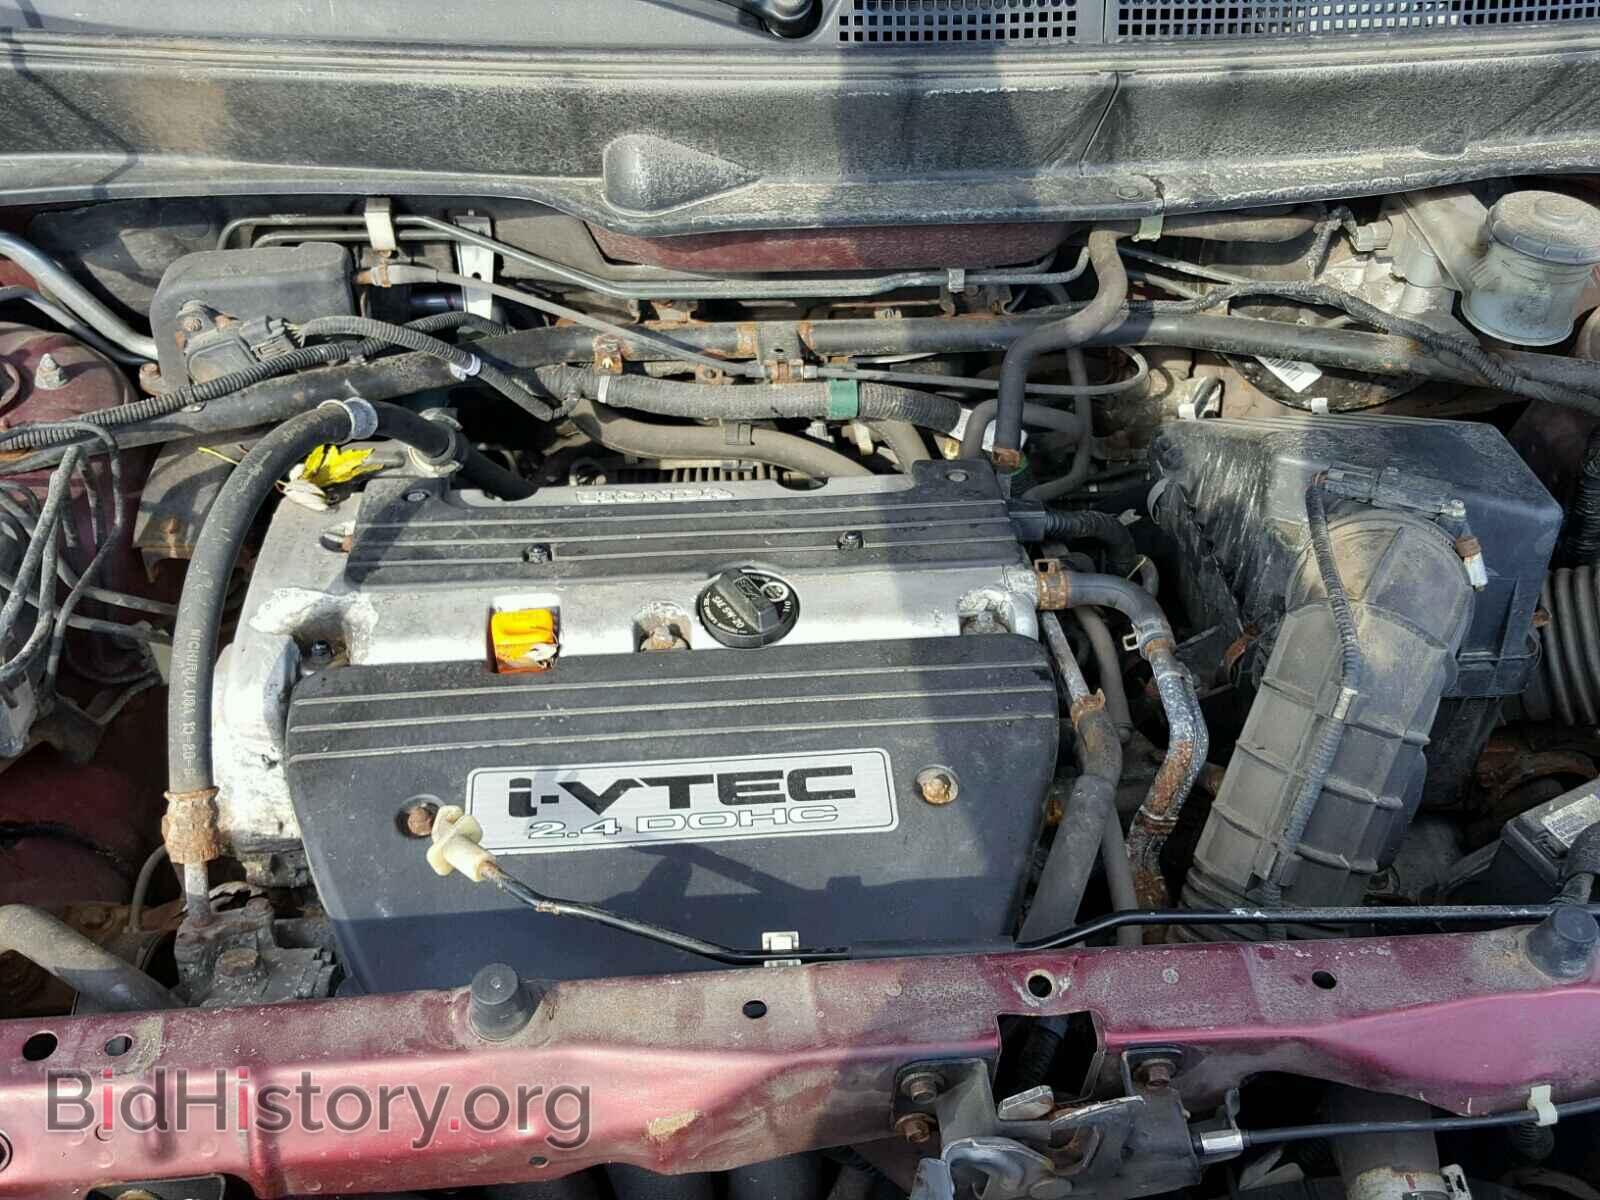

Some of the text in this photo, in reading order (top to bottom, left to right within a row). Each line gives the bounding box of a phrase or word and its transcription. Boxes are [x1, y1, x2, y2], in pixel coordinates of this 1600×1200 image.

[508, 766, 856, 818] i-VTEC
[528, 804, 838, 839] 2.4 DOHC
